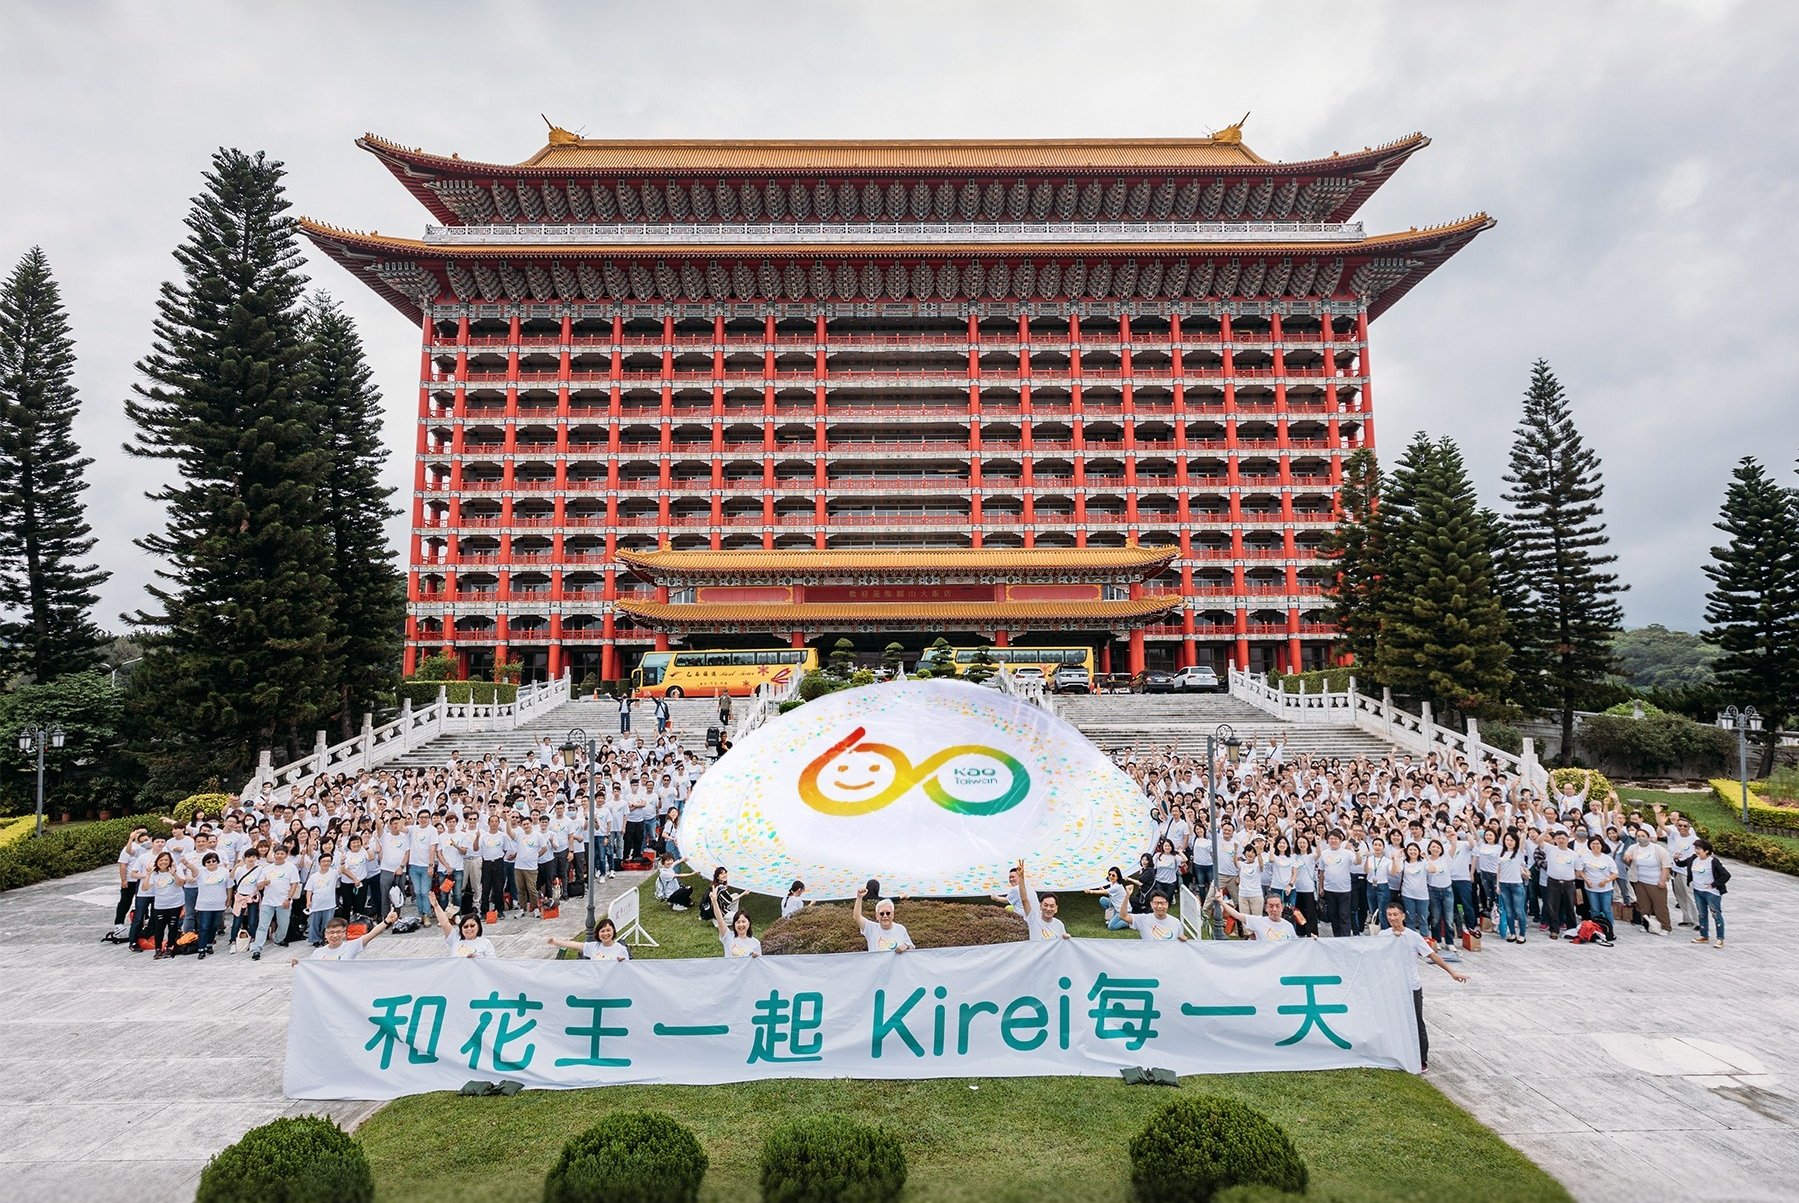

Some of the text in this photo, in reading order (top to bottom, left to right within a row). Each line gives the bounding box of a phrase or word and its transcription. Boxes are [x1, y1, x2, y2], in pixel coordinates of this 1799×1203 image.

[954, 767, 996, 777] Kao
[955, 777, 998, 786] Taiwan
[364, 989, 824, 1072] 和花王一起
